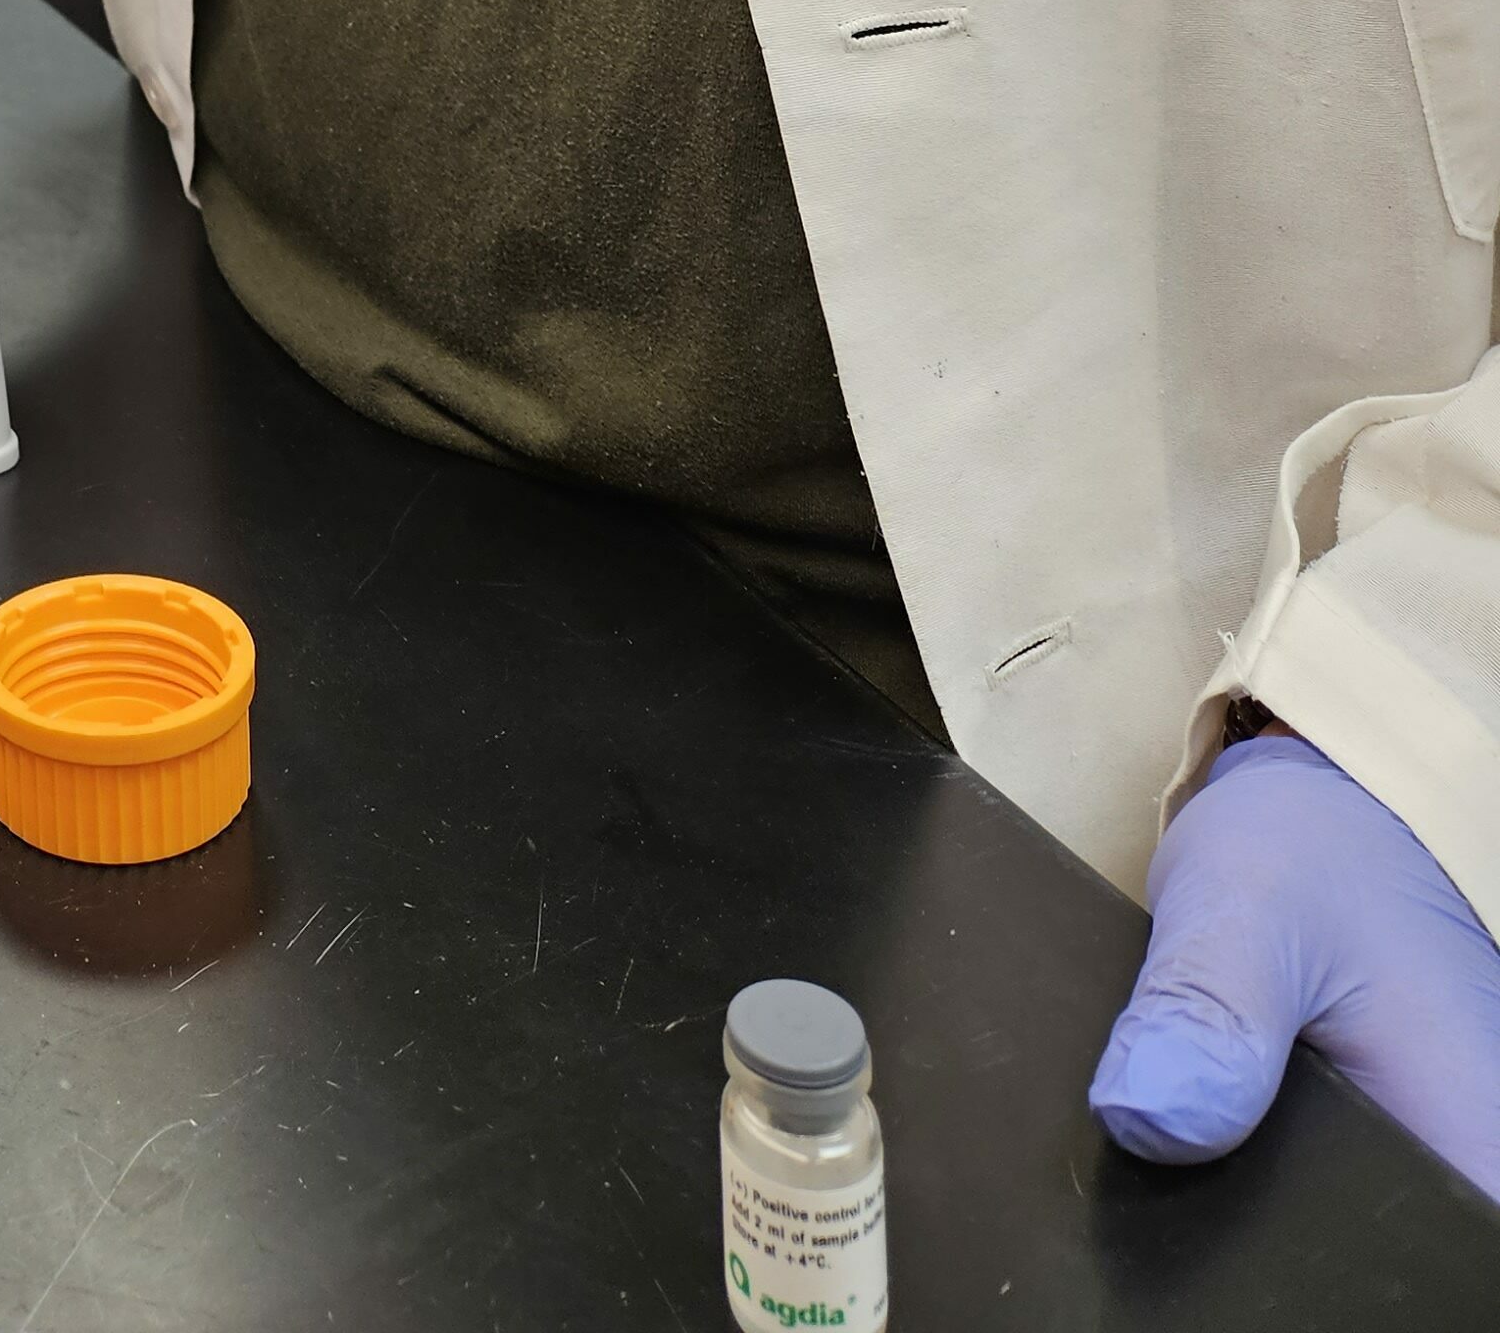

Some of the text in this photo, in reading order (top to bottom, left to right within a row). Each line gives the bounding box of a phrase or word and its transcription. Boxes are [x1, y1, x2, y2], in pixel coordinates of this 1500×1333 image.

[752, 1188, 809, 1222] Positive
[814, 1201, 861, 1224] control
[754, 1215, 762, 1229] 2
[767, 1223, 785, 1240] ml
[791, 1232, 805, 1246] of
[811, 1227, 859, 1250] sample
[763, 1243, 776, 1258] at
[760, 1293, 846, 1328] agdia
